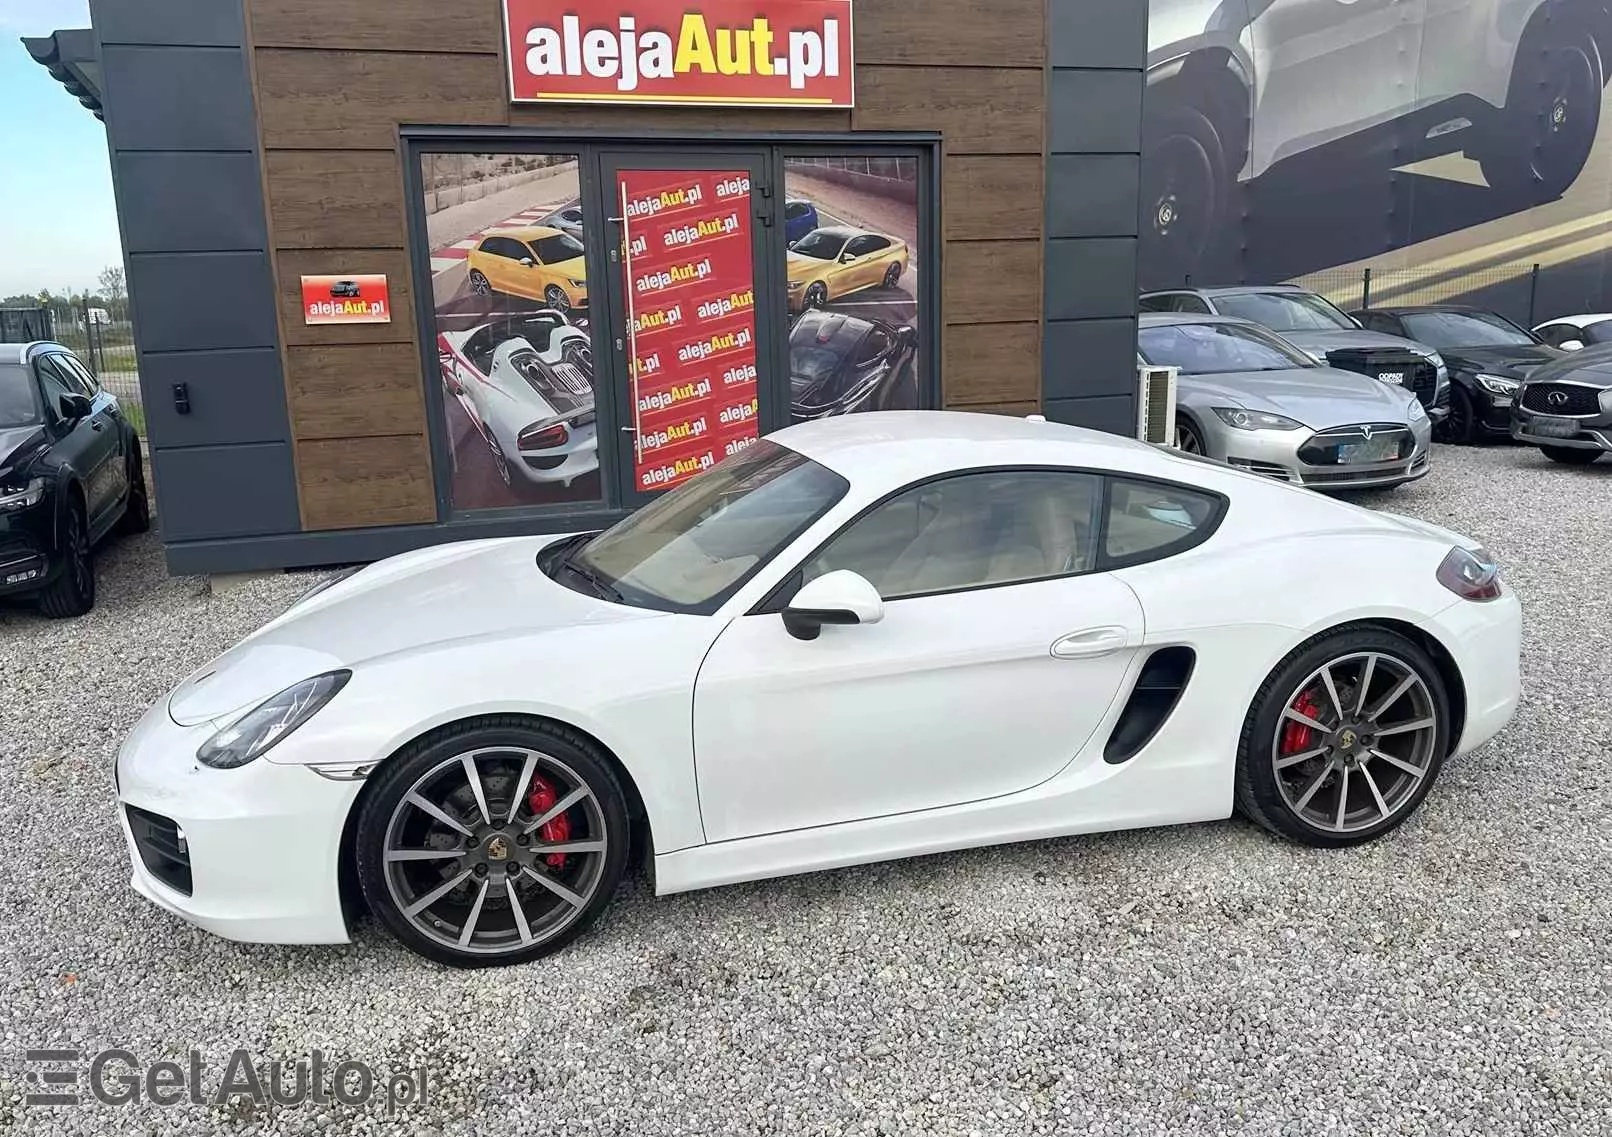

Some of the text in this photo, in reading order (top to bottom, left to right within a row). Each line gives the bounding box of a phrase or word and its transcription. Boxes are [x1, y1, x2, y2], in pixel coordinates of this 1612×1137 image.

[525, 13, 839, 91] alejaAut.pl
[627, 184, 702, 217] alejaAut.pl
[716, 176, 749, 198] aleja
[664, 213, 739, 245] alejaAut.pl
[636, 257, 712, 292] alejaAut.pl
[309, 300, 385, 317] alejaAut.pl
[678, 327, 752, 361] alejaAut.pl
[723, 364, 757, 384] aleja
[639, 377, 712, 412] alejaAut.pl
[642, 451, 715, 487] alejaAut.pl
